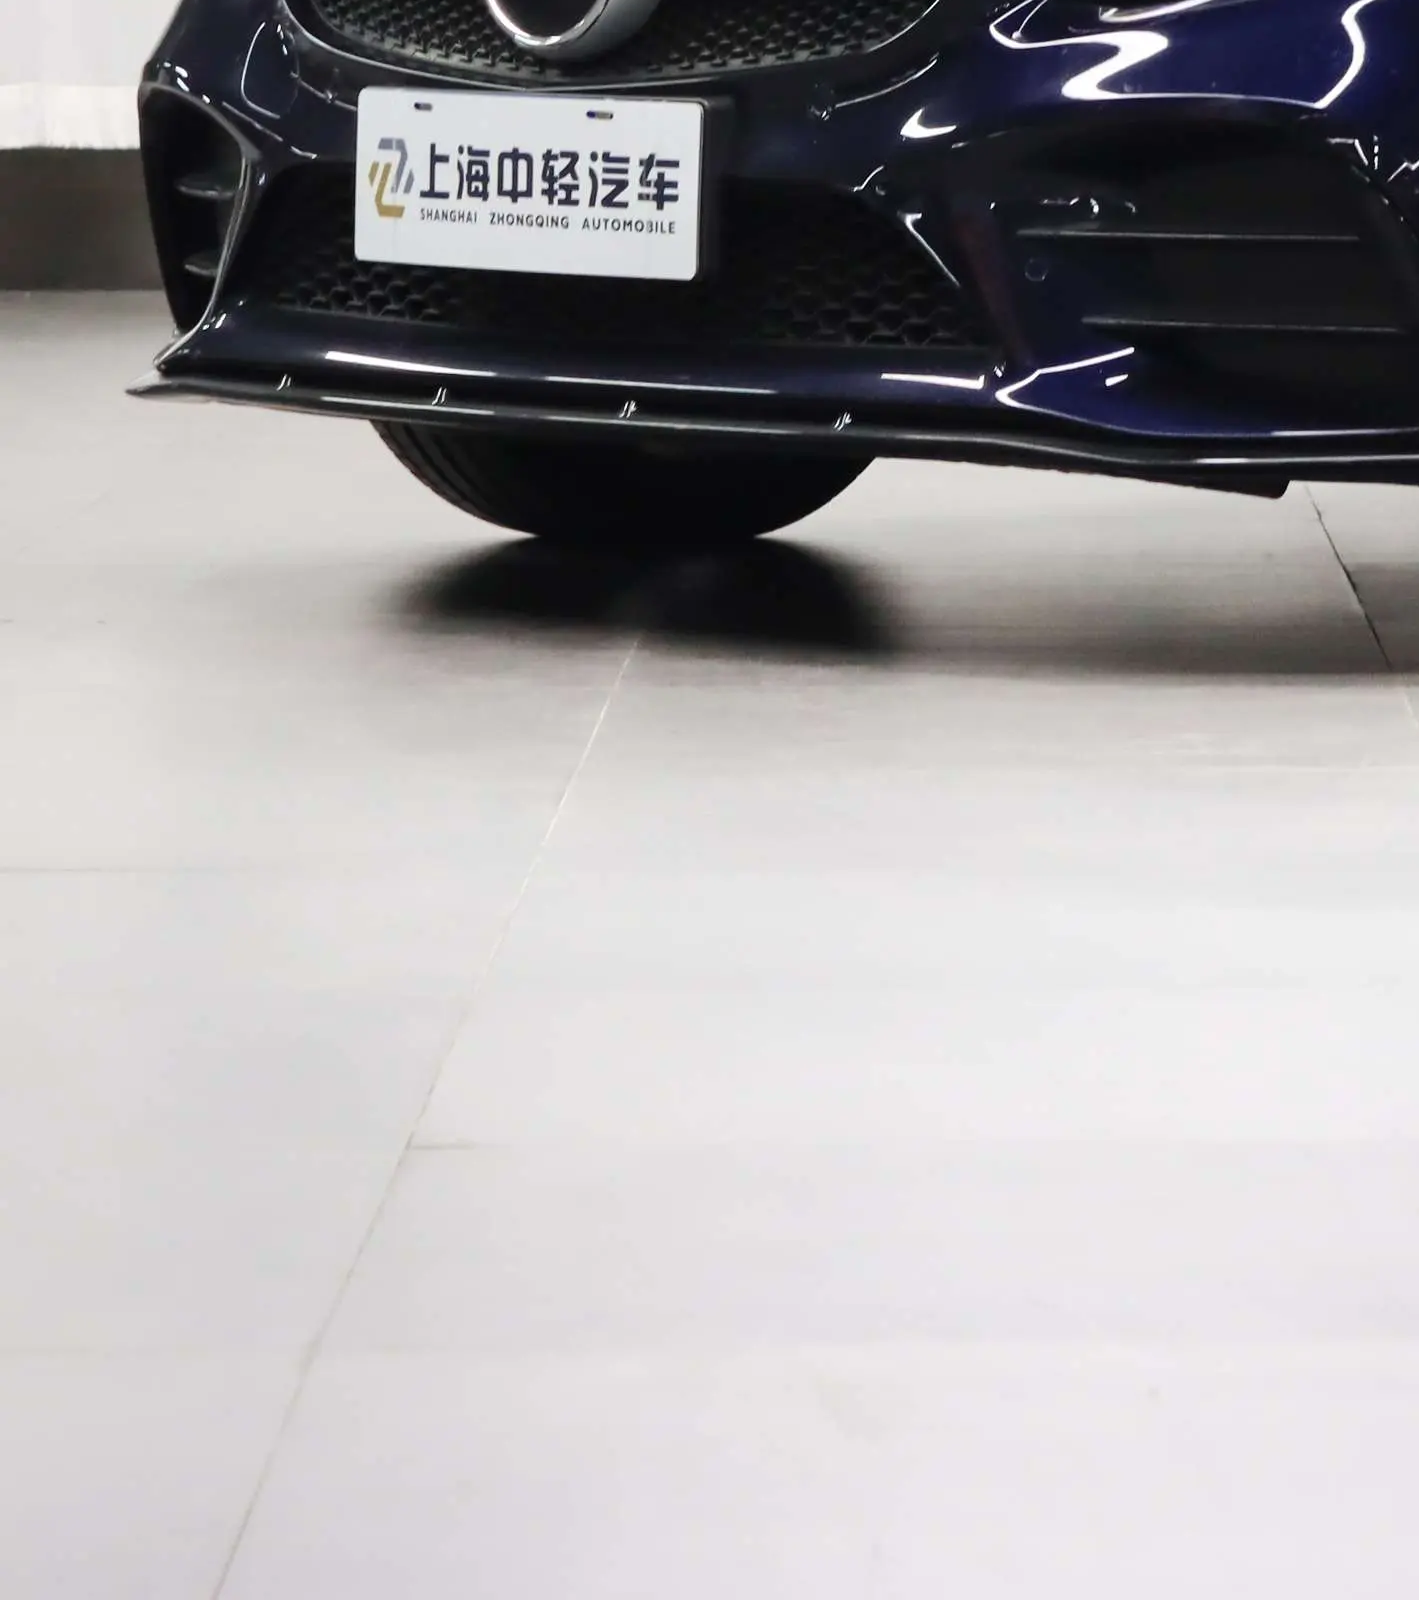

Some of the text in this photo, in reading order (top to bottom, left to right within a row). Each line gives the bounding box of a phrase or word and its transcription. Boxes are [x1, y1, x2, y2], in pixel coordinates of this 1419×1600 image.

[419, 142, 680, 211] 上海中轻汽车
[419, 208, 676, 235] SHANGHAI ZHONGQING AUTOMOBILE
